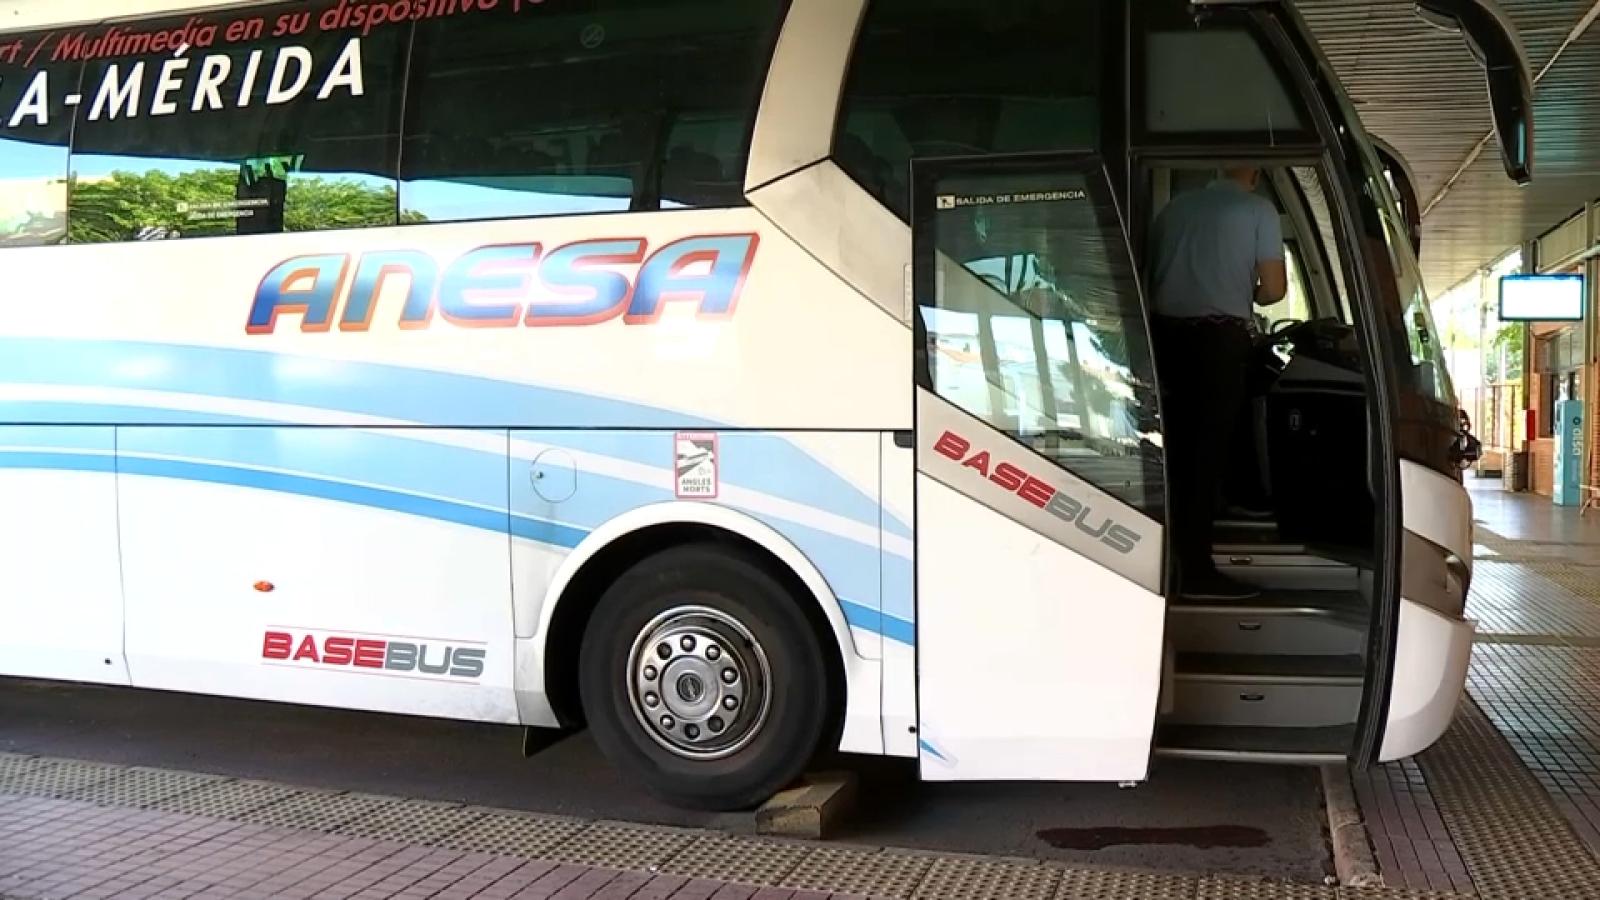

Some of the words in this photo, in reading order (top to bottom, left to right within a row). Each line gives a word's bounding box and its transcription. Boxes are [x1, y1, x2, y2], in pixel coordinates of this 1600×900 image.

[51, 16, 218, 61] Multimedia
[226, 18, 264, 42] en
[272, 12, 310, 36] su
[0, 38, 364, 127] A-MÉRIDA
[956, 196, 994, 206] SALIDA
[997, 194, 1011, 203] DE
[1014, 189, 1085, 202] EMERGENCIA
[245, 232, 760, 334] ANESA
[933, 430, 1141, 554] BASEBUS
[262, 631, 486, 678] BASEBUS
